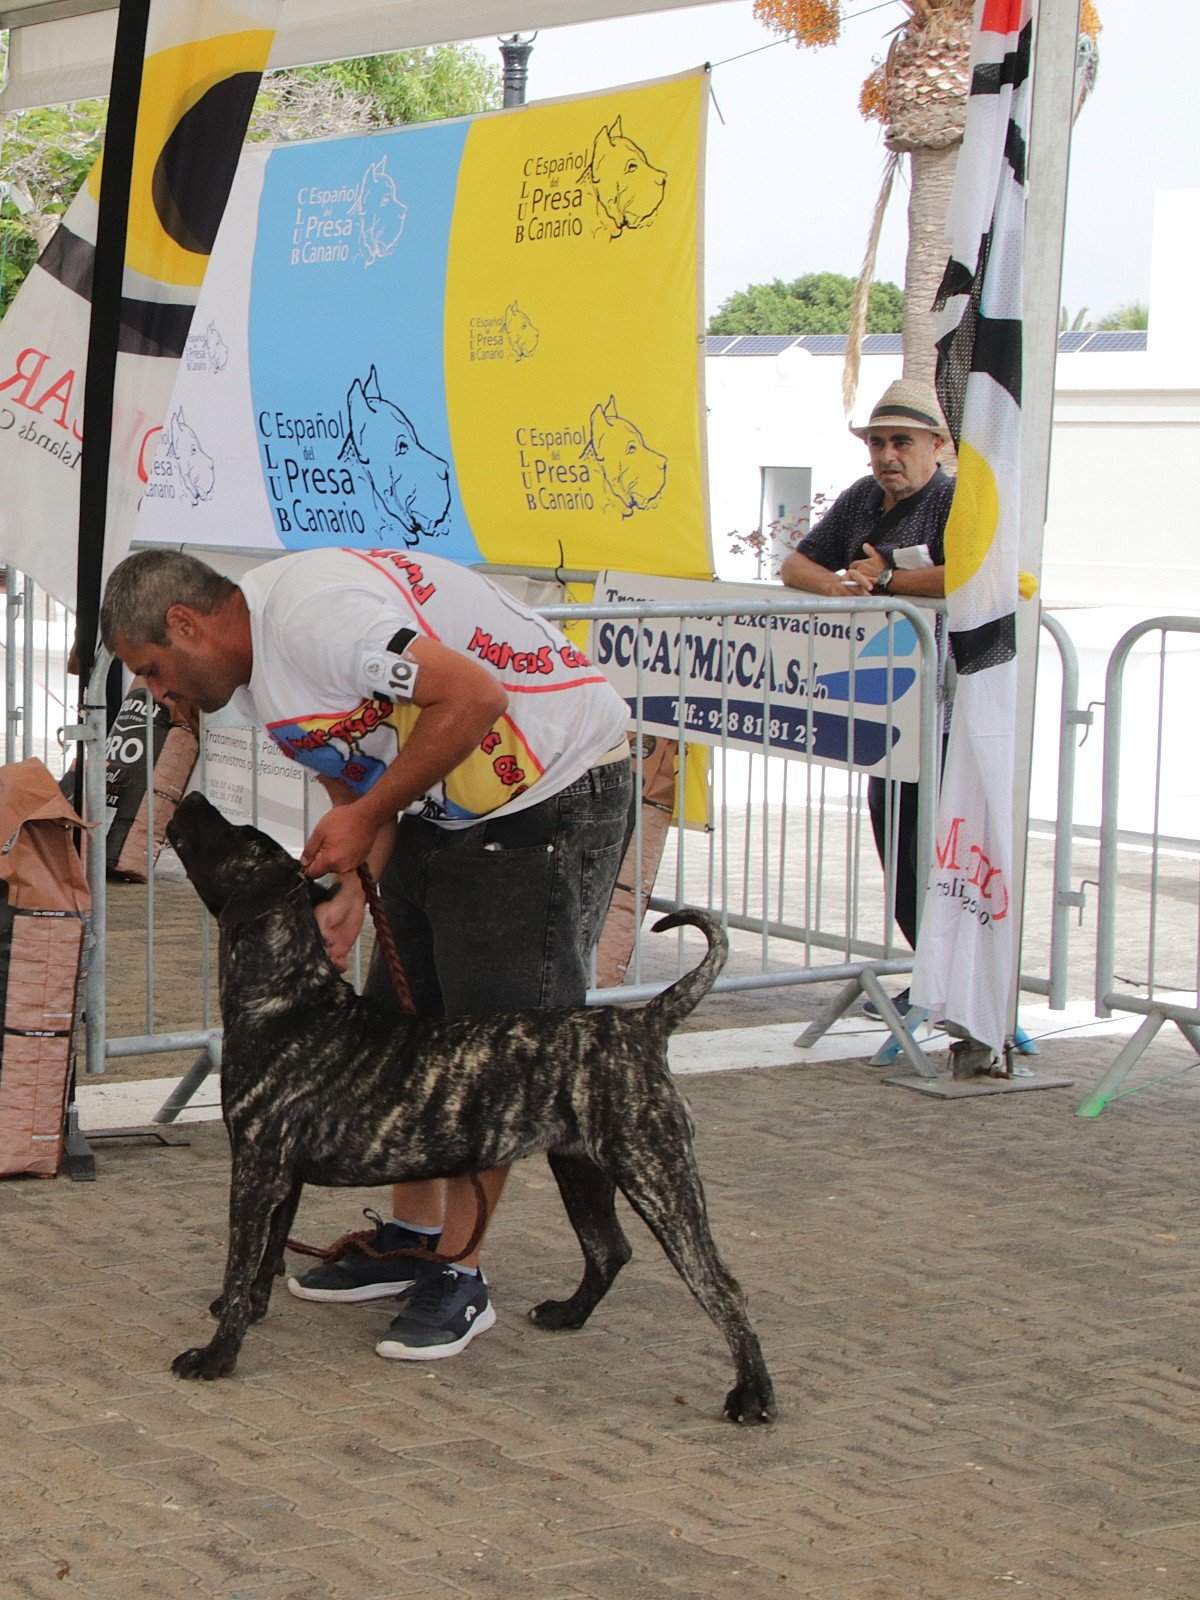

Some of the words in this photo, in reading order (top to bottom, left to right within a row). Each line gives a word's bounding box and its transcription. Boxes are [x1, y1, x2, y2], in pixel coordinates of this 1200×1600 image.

[535, 148, 588, 178] Español
[309, 183, 360, 209] Español
[532, 188, 583, 213] Presa
[305, 215, 353, 239] Presa
[528, 211, 583, 241] Canario
[302, 239, 350, 264] Canario
[476, 333, 504, 346] Presa
[275, 410, 345, 446] Español
[529, 424, 587, 451] Español
[284, 458, 356, 496] Presa
[534, 458, 591, 484] Presa
[538, 487, 595, 511] Canario
[292, 498, 366, 534] Canario
[466, 626, 554, 675] Marcos
[388, 662, 413, 690] 10
[742, 714, 763, 736] 81
[768, 719, 789, 741] 81
